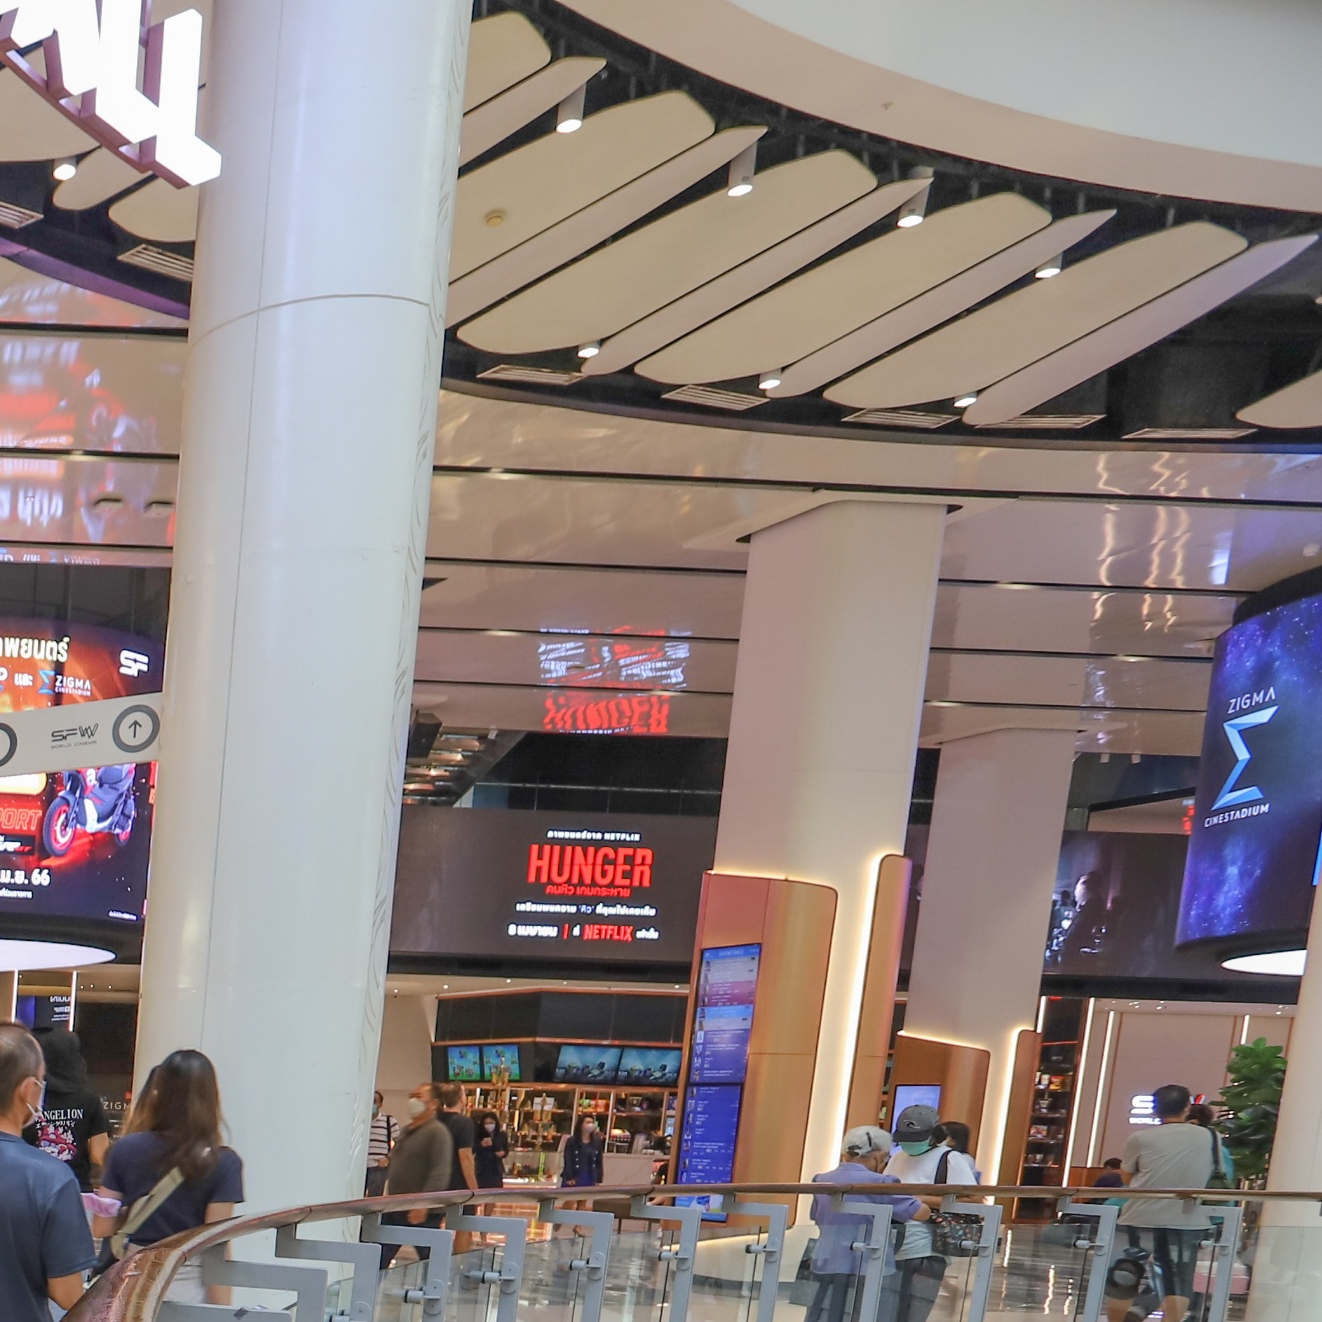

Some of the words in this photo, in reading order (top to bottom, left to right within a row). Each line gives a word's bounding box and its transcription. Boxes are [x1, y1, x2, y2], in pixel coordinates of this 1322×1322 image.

[119, 649, 150, 677] SF
[55, 675, 91, 690] ZIGMA
[1227, 686, 1276, 714] ZIGMA
[1204, 803, 1270, 828] CINESTADIUM
[604, 832, 641, 842] NETFLIX
[527, 843, 654, 887] HUNGER
[31, 868, 50, 886] 66
[582, 924, 634, 941] NETFLIX
[103, 1101, 129, 1110] ZIGM
